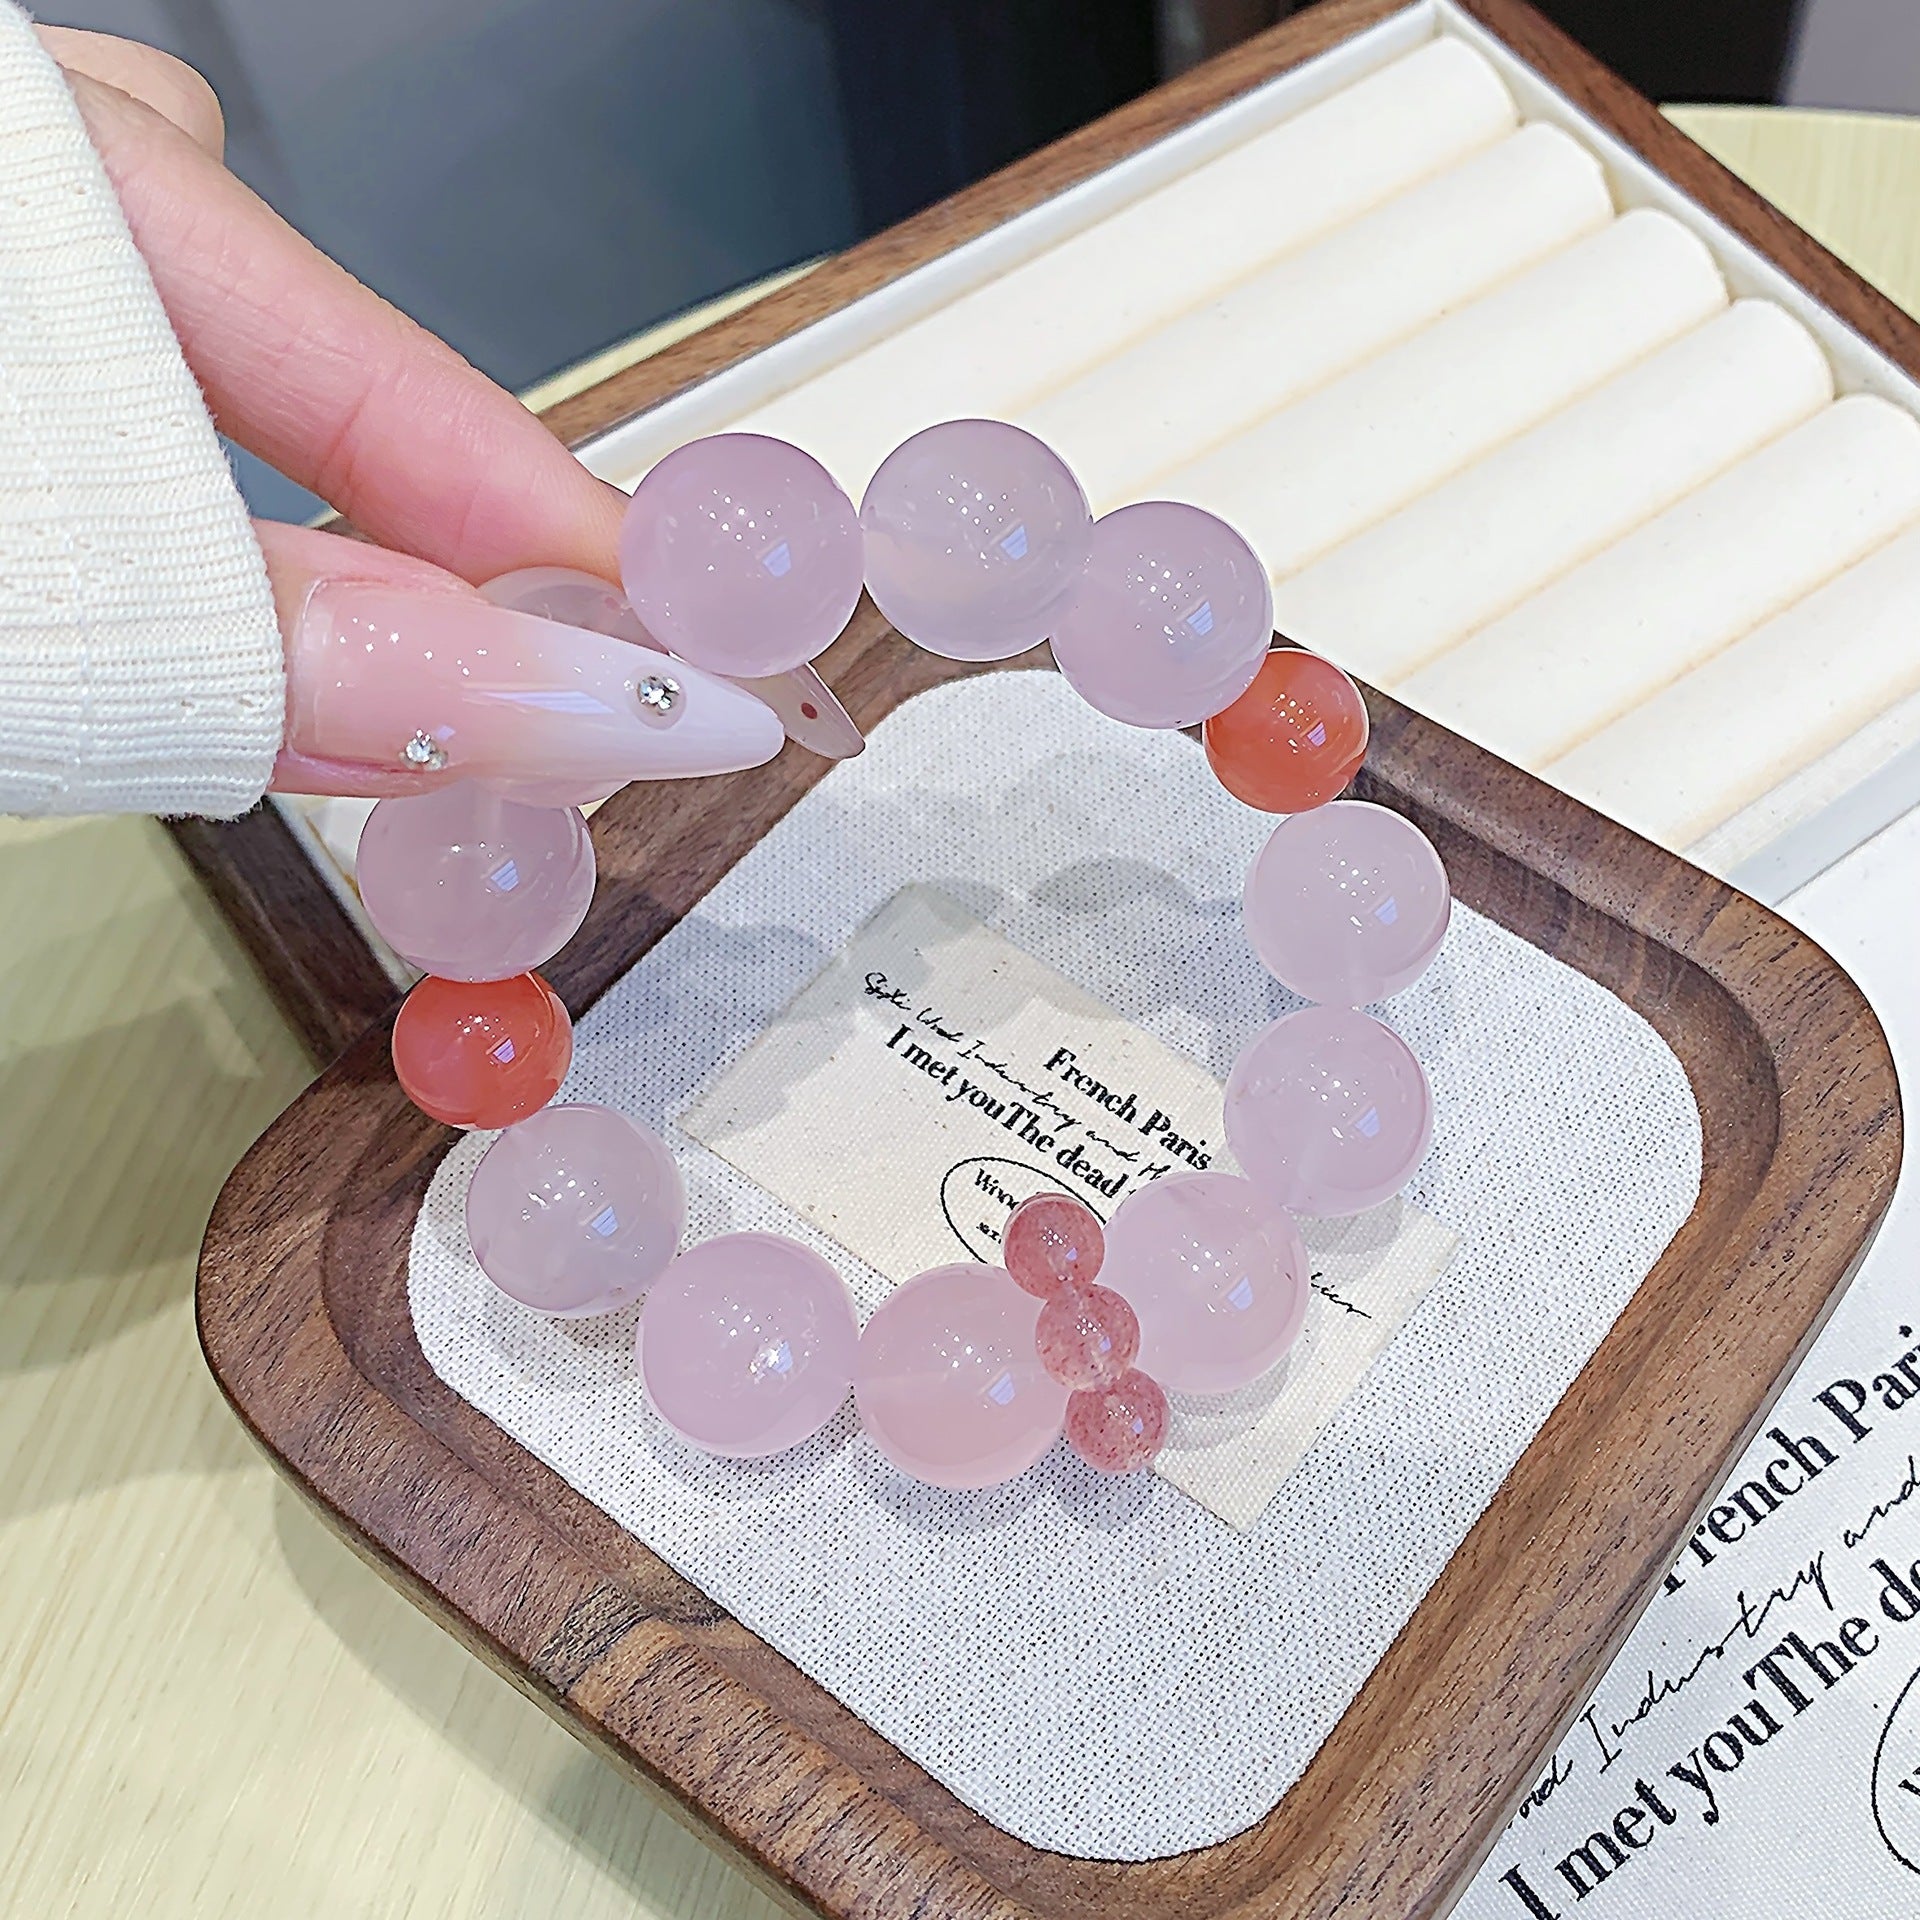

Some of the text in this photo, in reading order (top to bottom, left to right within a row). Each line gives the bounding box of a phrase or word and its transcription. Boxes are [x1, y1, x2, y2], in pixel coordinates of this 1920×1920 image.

[885, 1023, 913, 1049] I
[900, 1045, 961, 1087] met
[1056, 1145, 1129, 1199] dead
[1043, 1047, 1212, 1171] French Paris
[1812, 1325, 1920, 1443] Par
[1579, 1551, 1834, 1774] Industry
[1555, 1778, 1676, 1902] met
